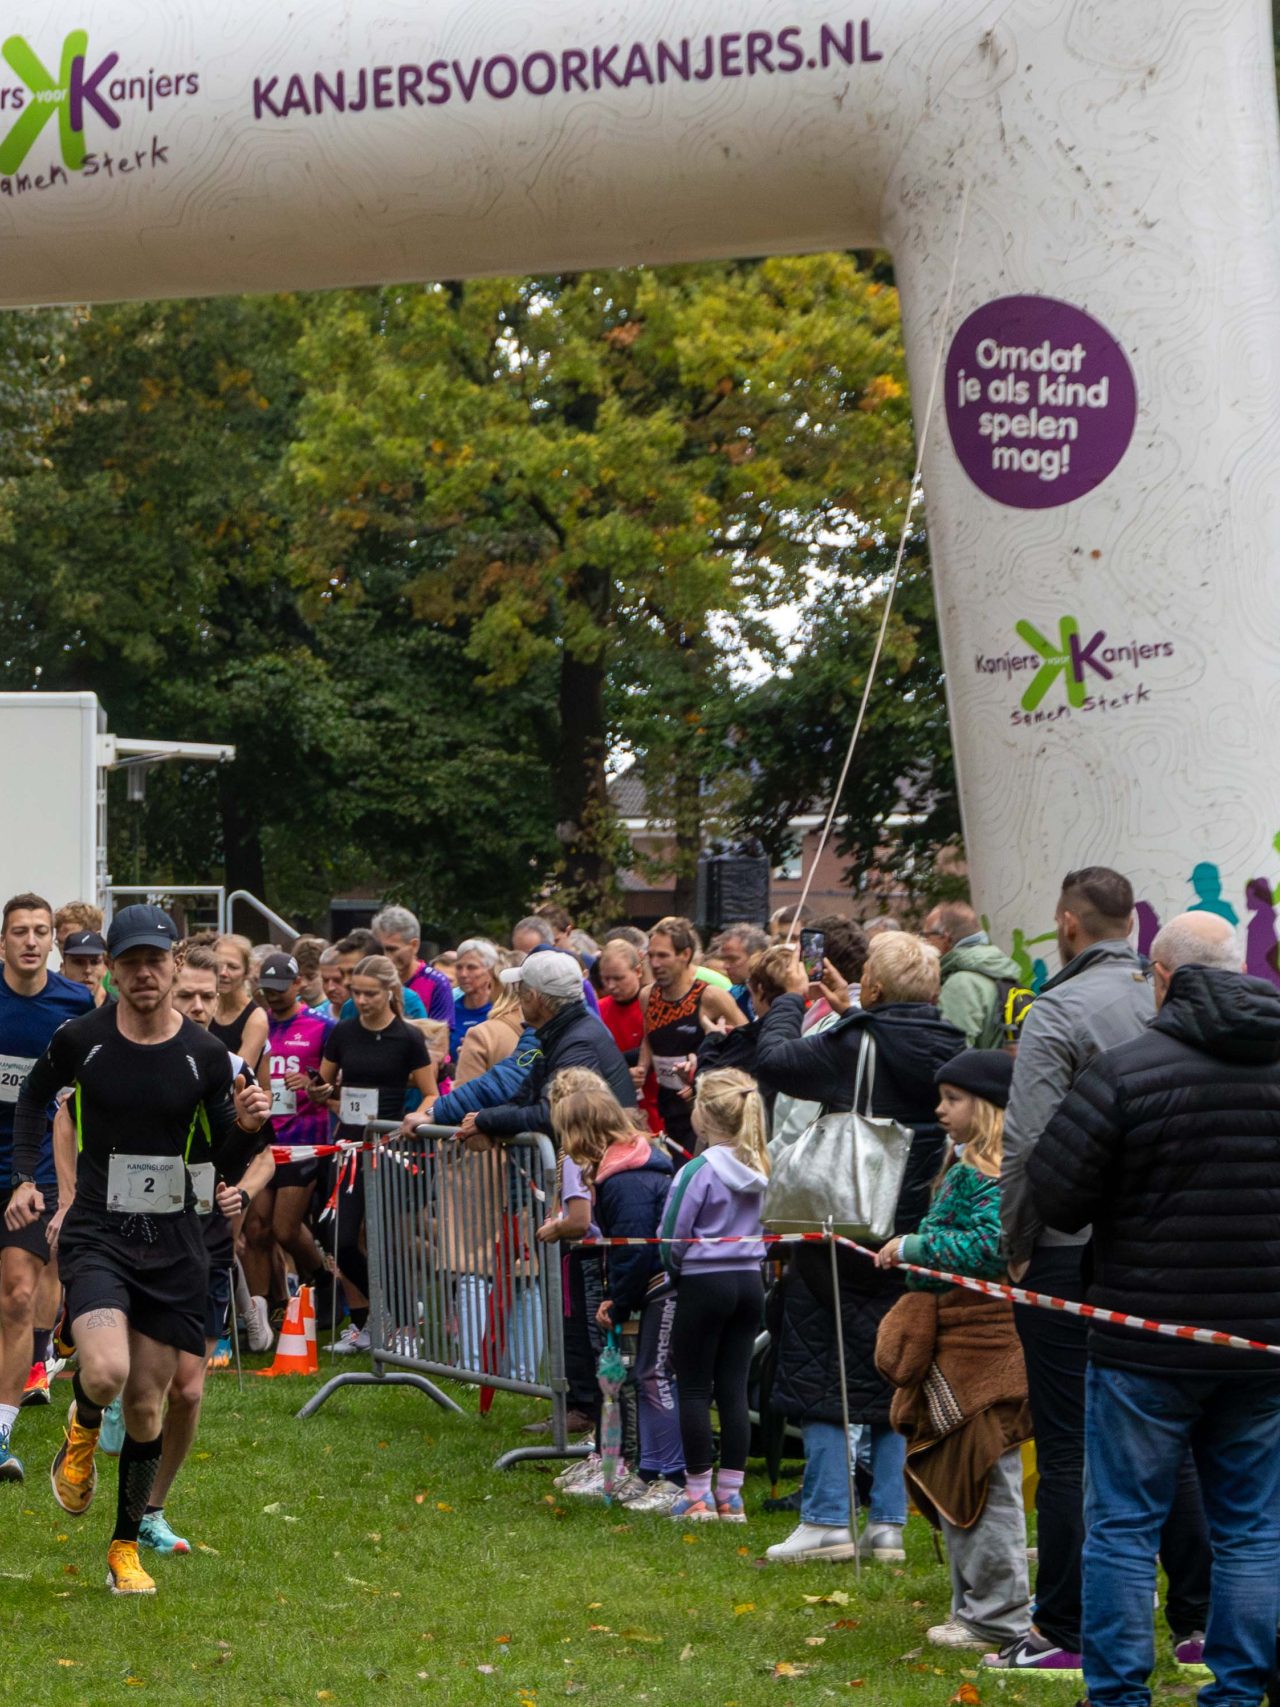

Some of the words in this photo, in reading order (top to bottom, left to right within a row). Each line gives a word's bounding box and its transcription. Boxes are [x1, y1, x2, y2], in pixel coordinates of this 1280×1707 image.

[253, 18, 884, 120] KANJERSVOORKANJERS.NL
[35, 87, 68, 103] voor
[80, 135, 169, 177] Sterk
[976, 338, 1087, 373] Omdat
[957, 368, 981, 408] je
[987, 372, 1030, 405] als
[1038, 373, 1110, 408] kind
[978, 407, 1079, 444] spelen
[992, 443, 1070, 481] mag!
[974, 652, 1041, 681] Kanjers
[350, 1101, 360, 1112] 13
[143, 1177, 155, 1193] 2
